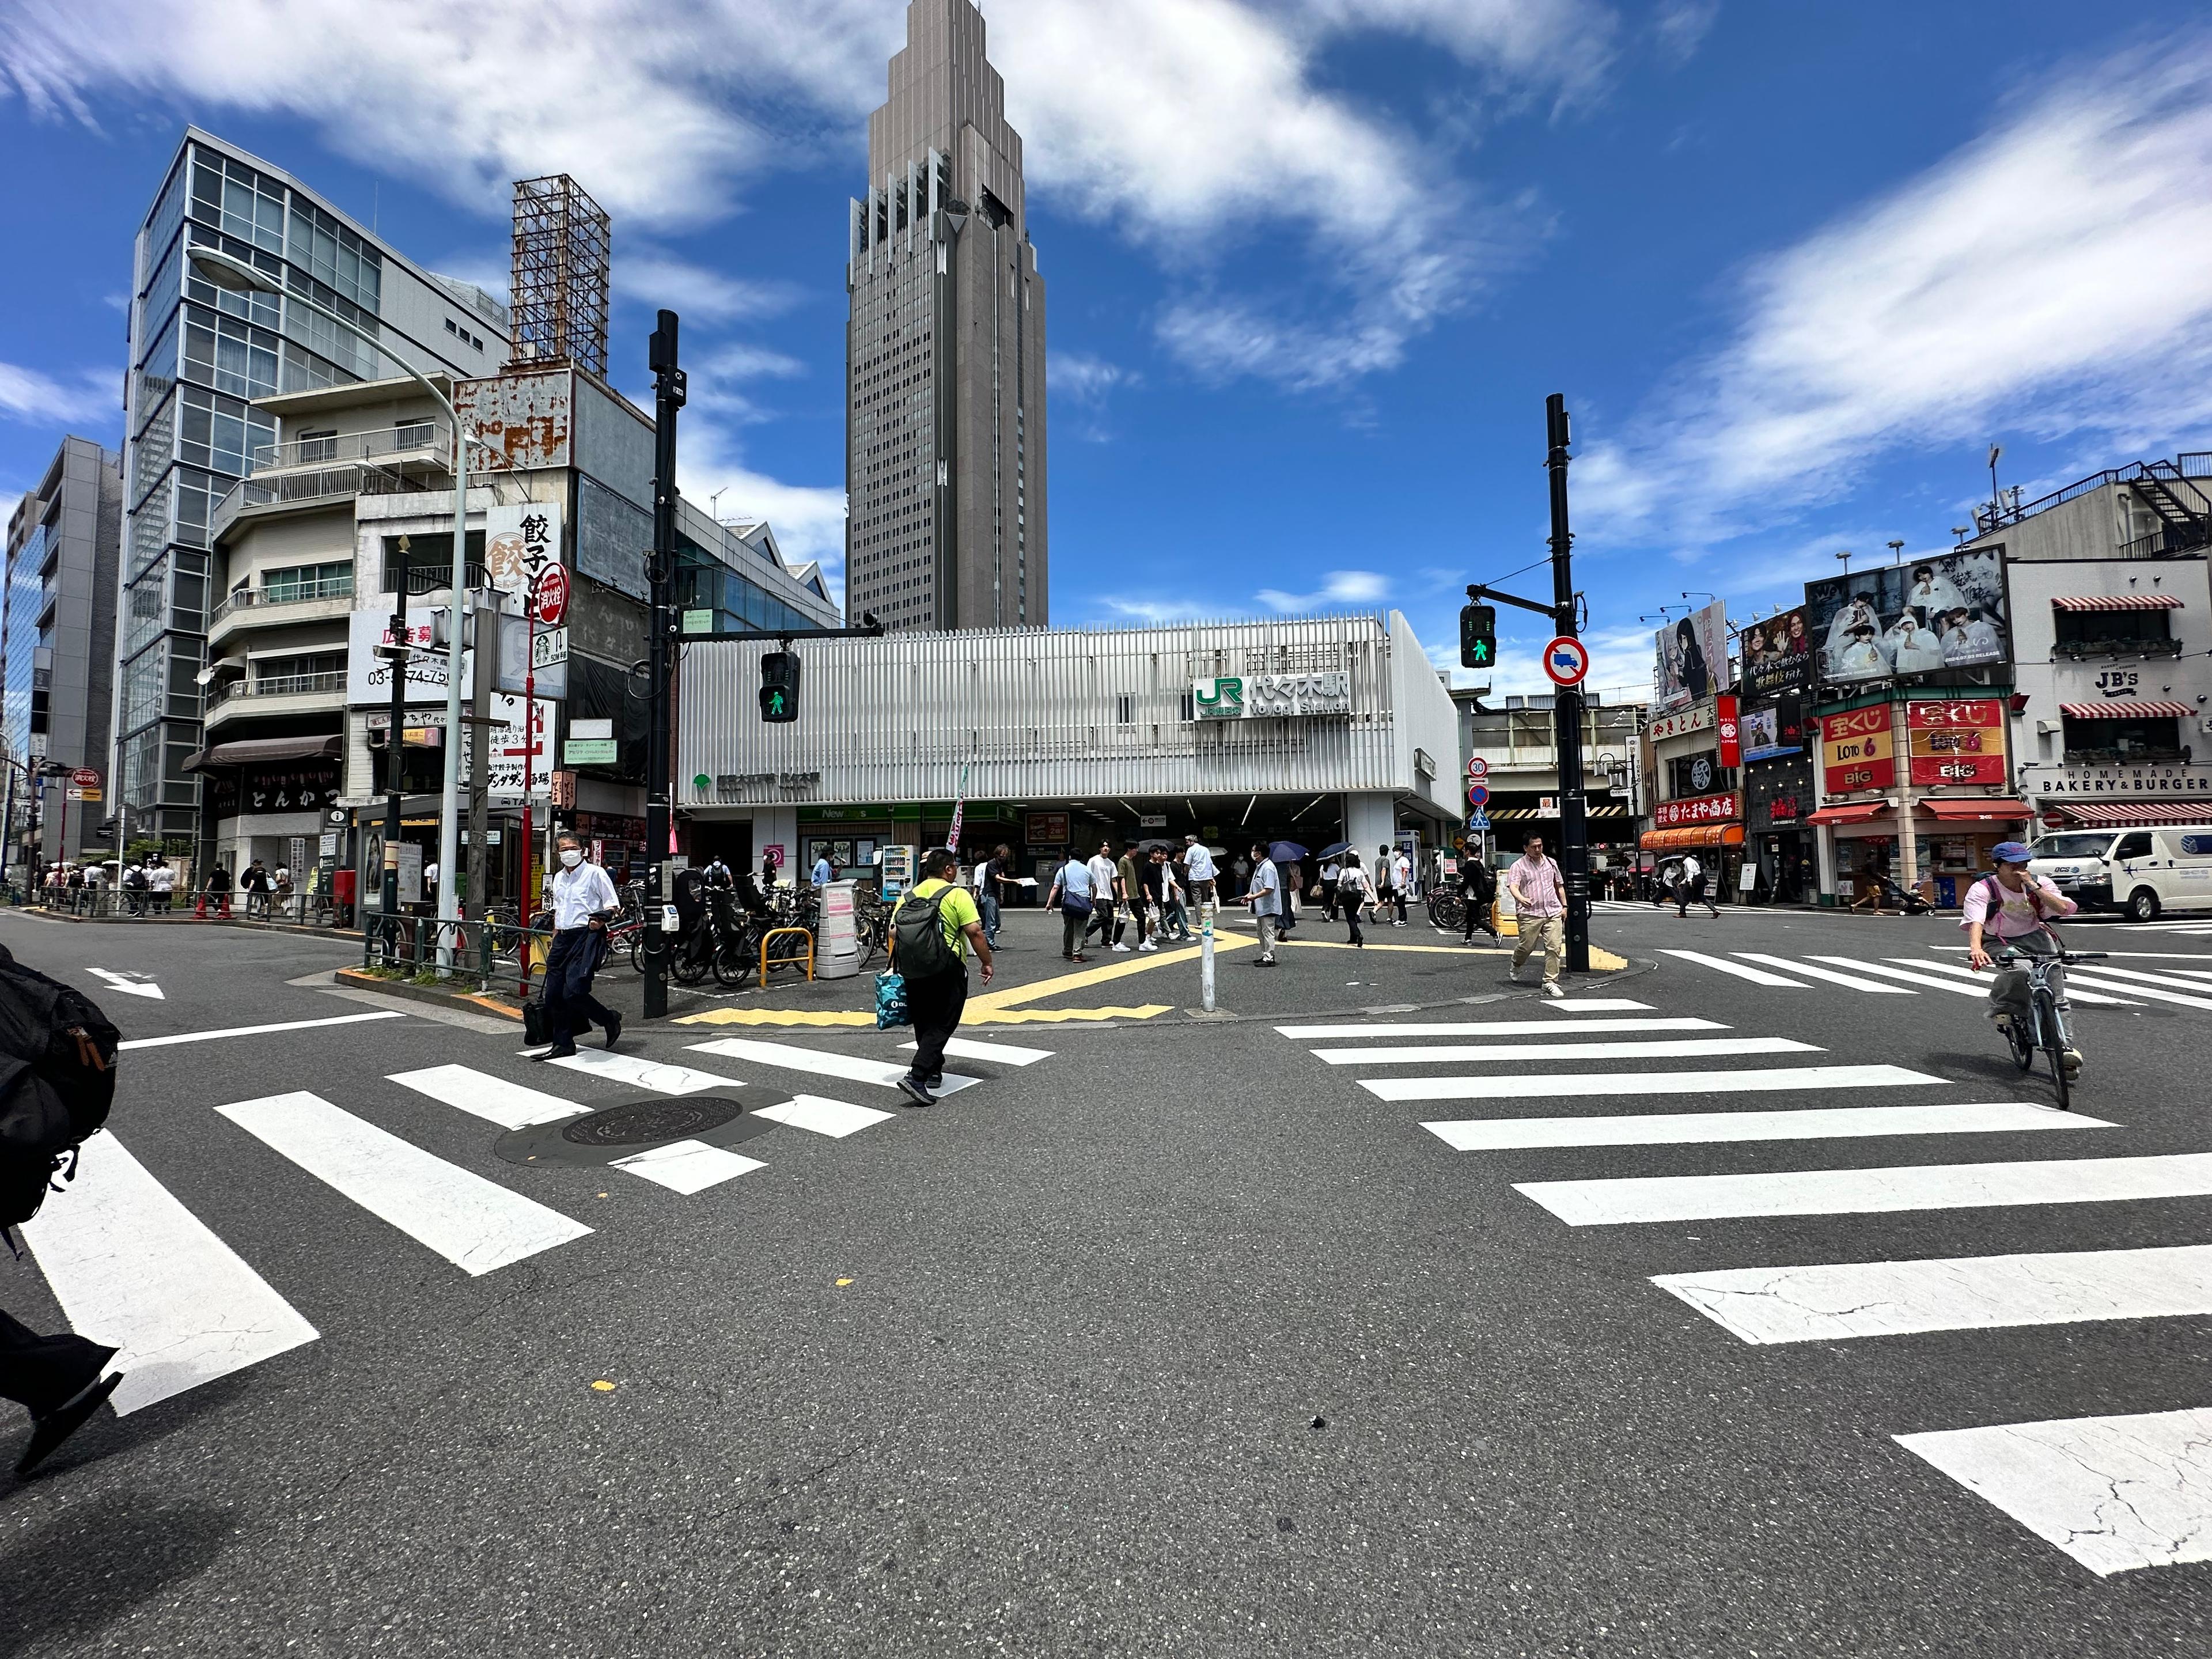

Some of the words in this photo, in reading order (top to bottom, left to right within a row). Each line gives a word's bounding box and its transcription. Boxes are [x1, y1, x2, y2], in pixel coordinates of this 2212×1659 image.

[540, 588, 562, 611] 消火栓
[1196, 677, 1244, 705] JR
[1249, 672, 1349, 701] 代々木駅
[1200, 706, 1243, 717] JR東日本
[1250, 702, 1294, 716] Yoyogi
[1300, 700, 1350, 712] Station
[1653, 713, 1701, 737] やきとん
[1830, 709, 1881, 738] 宝くじ
[1837, 745, 1859, 761] LOTO
[1863, 737, 1876, 757] 6
[1472, 763, 1484, 772] 30
[1940, 764, 1976, 778] BIG
[2067, 769, 2188, 779] HOMEMADE
[1844, 771, 1872, 785] BIG
[2043, 780, 2116, 792] BAKERY
[2121, 782, 2128, 790] &
[2134, 779, 2208, 790] BURGER
[252, 789, 341, 807] とんかつ
[822, 809, 866, 818] News
[1681, 797, 1733, 820] たまや商店
